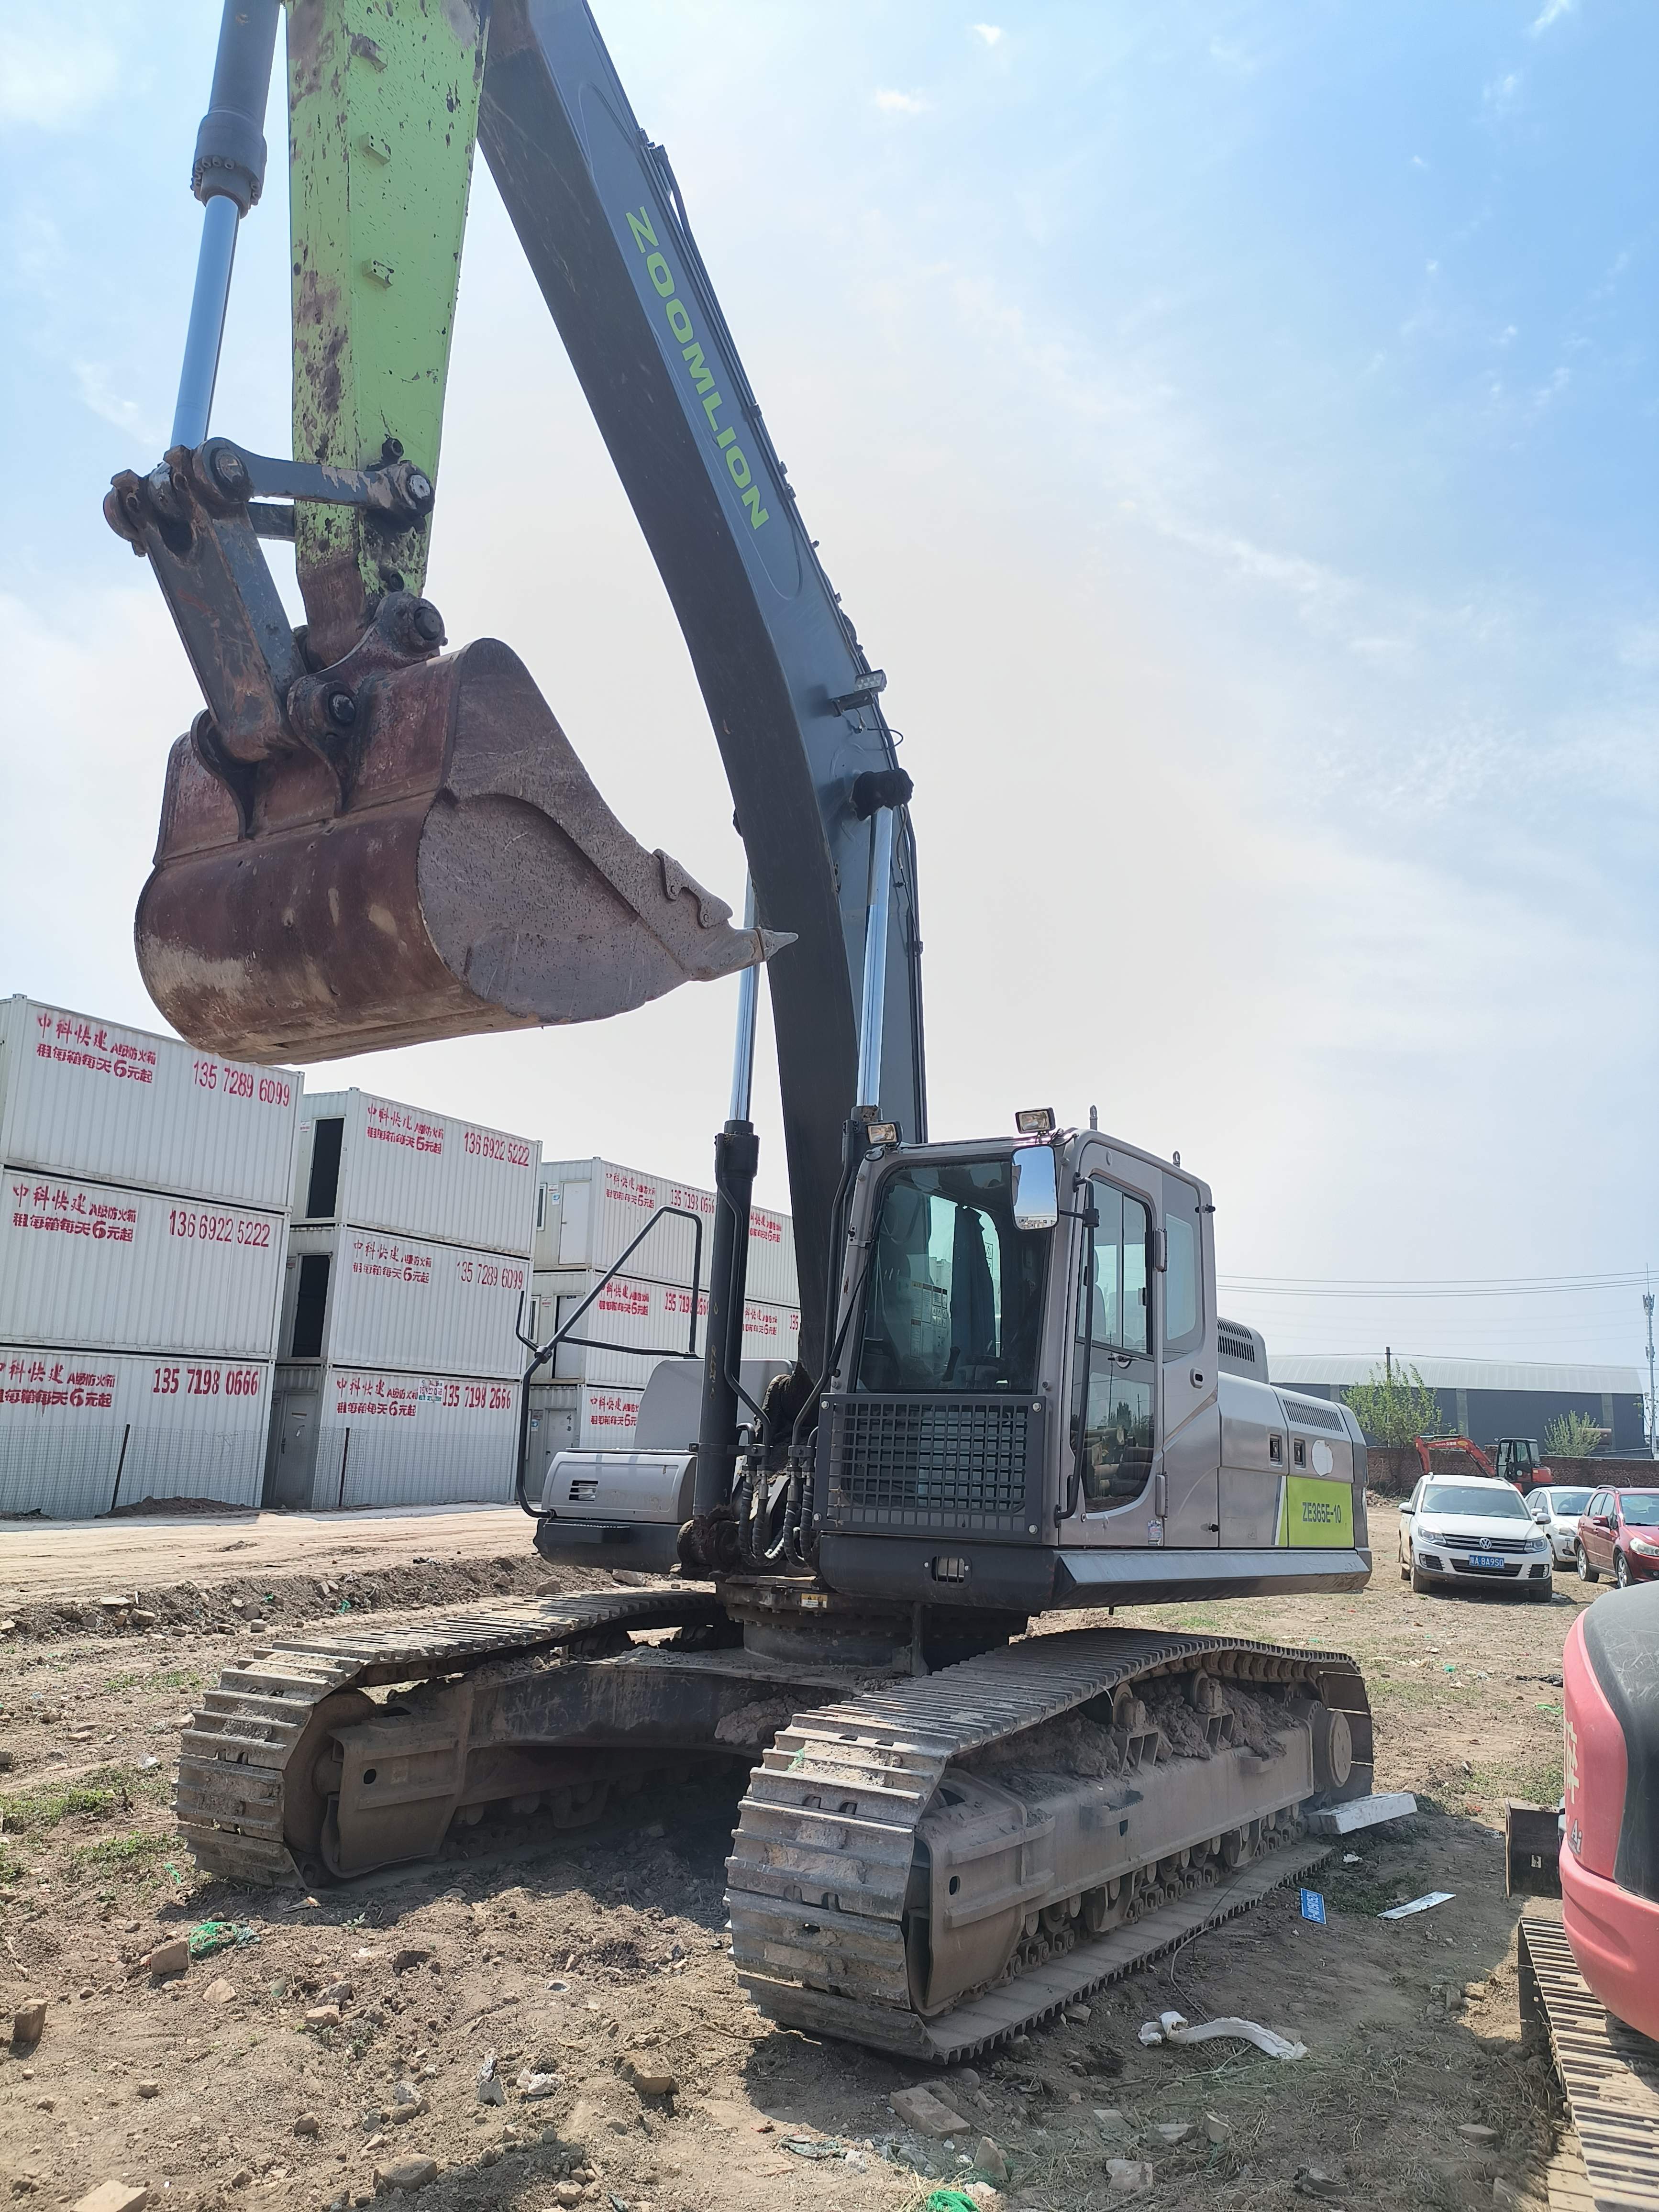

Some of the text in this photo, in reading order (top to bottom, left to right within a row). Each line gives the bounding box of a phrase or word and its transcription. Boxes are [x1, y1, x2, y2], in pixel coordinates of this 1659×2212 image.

[626, 206, 769, 530] ZOOMLION
[194, 1060, 289, 1106] 135 7289 6099
[465, 1132, 530, 1167] 136 6922 5222
[671, 1189, 681, 1206] 135
[170, 1209, 270, 1247] 136 6922 5222
[477, 1263, 498, 1286] 7289
[502, 1268, 523, 1290] 6099
[665, 1292, 676, 1311] 135
[153, 1368, 258, 1395] 135 7198 0666
[443, 1385, 460, 1407] 135
[465, 1386, 487, 1408] 7198
[489, 1388, 511, 1409] 2666
[1302, 1502, 1341, 1523] ZE365E-10
